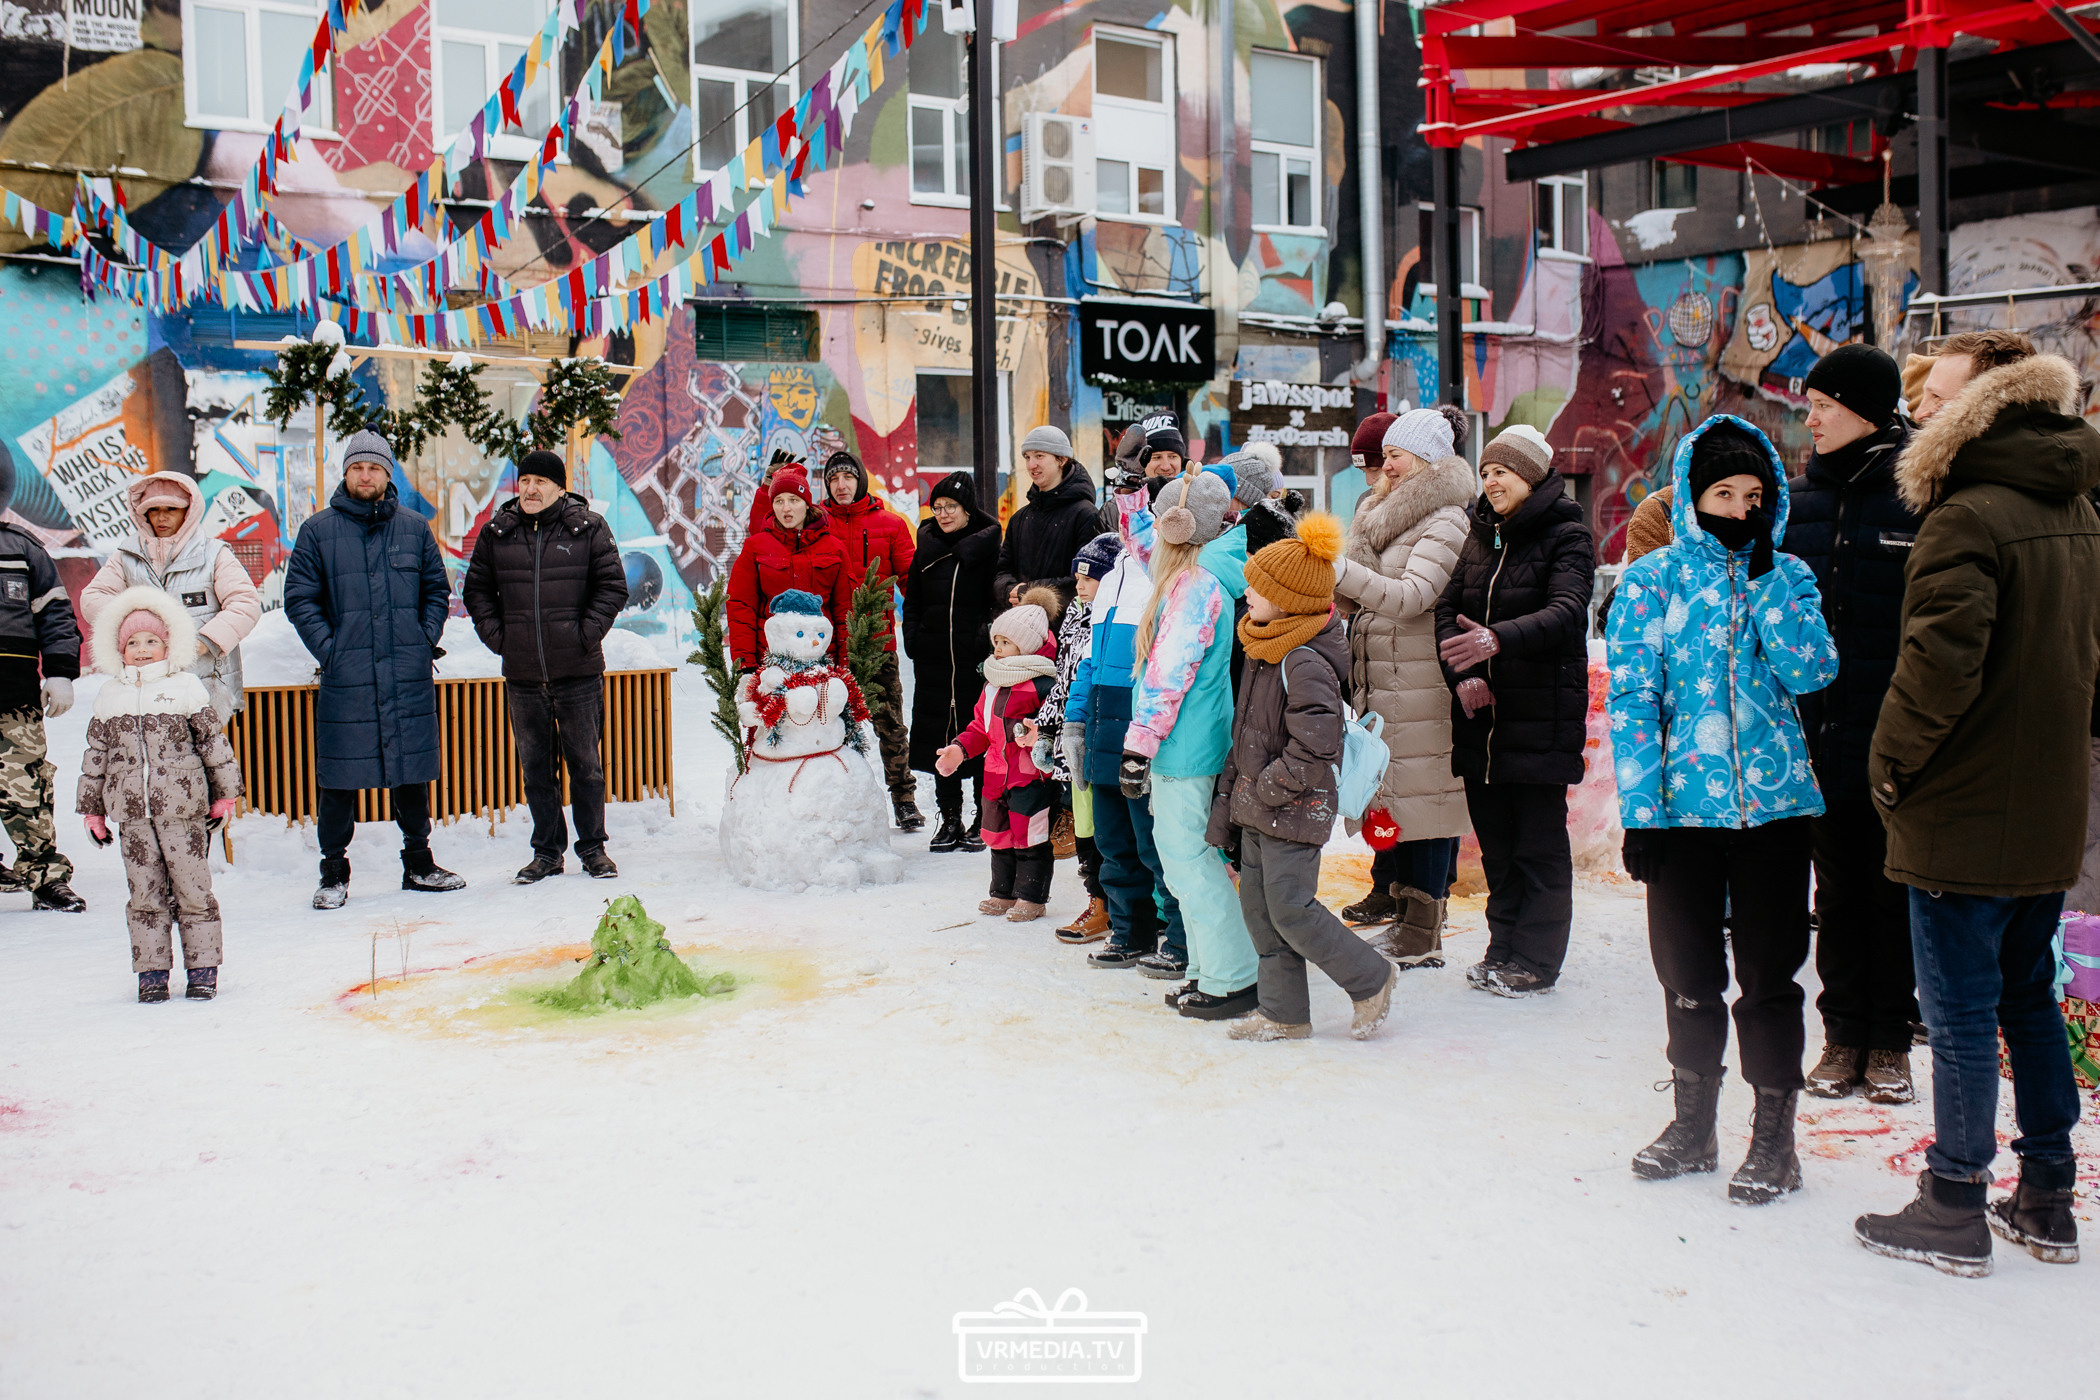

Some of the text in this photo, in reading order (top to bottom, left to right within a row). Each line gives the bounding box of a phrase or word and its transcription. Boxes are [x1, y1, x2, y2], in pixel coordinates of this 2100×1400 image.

[874, 241, 1029, 309] NCREDLE
[918, 327, 962, 353] gives
[1238, 378, 1355, 414] jawsspot
[1142, 416, 1174, 431] NIKE
[53, 448, 101, 486] WHO
[98, 435, 122, 460] IS
[115, 450, 149, 480] THE
